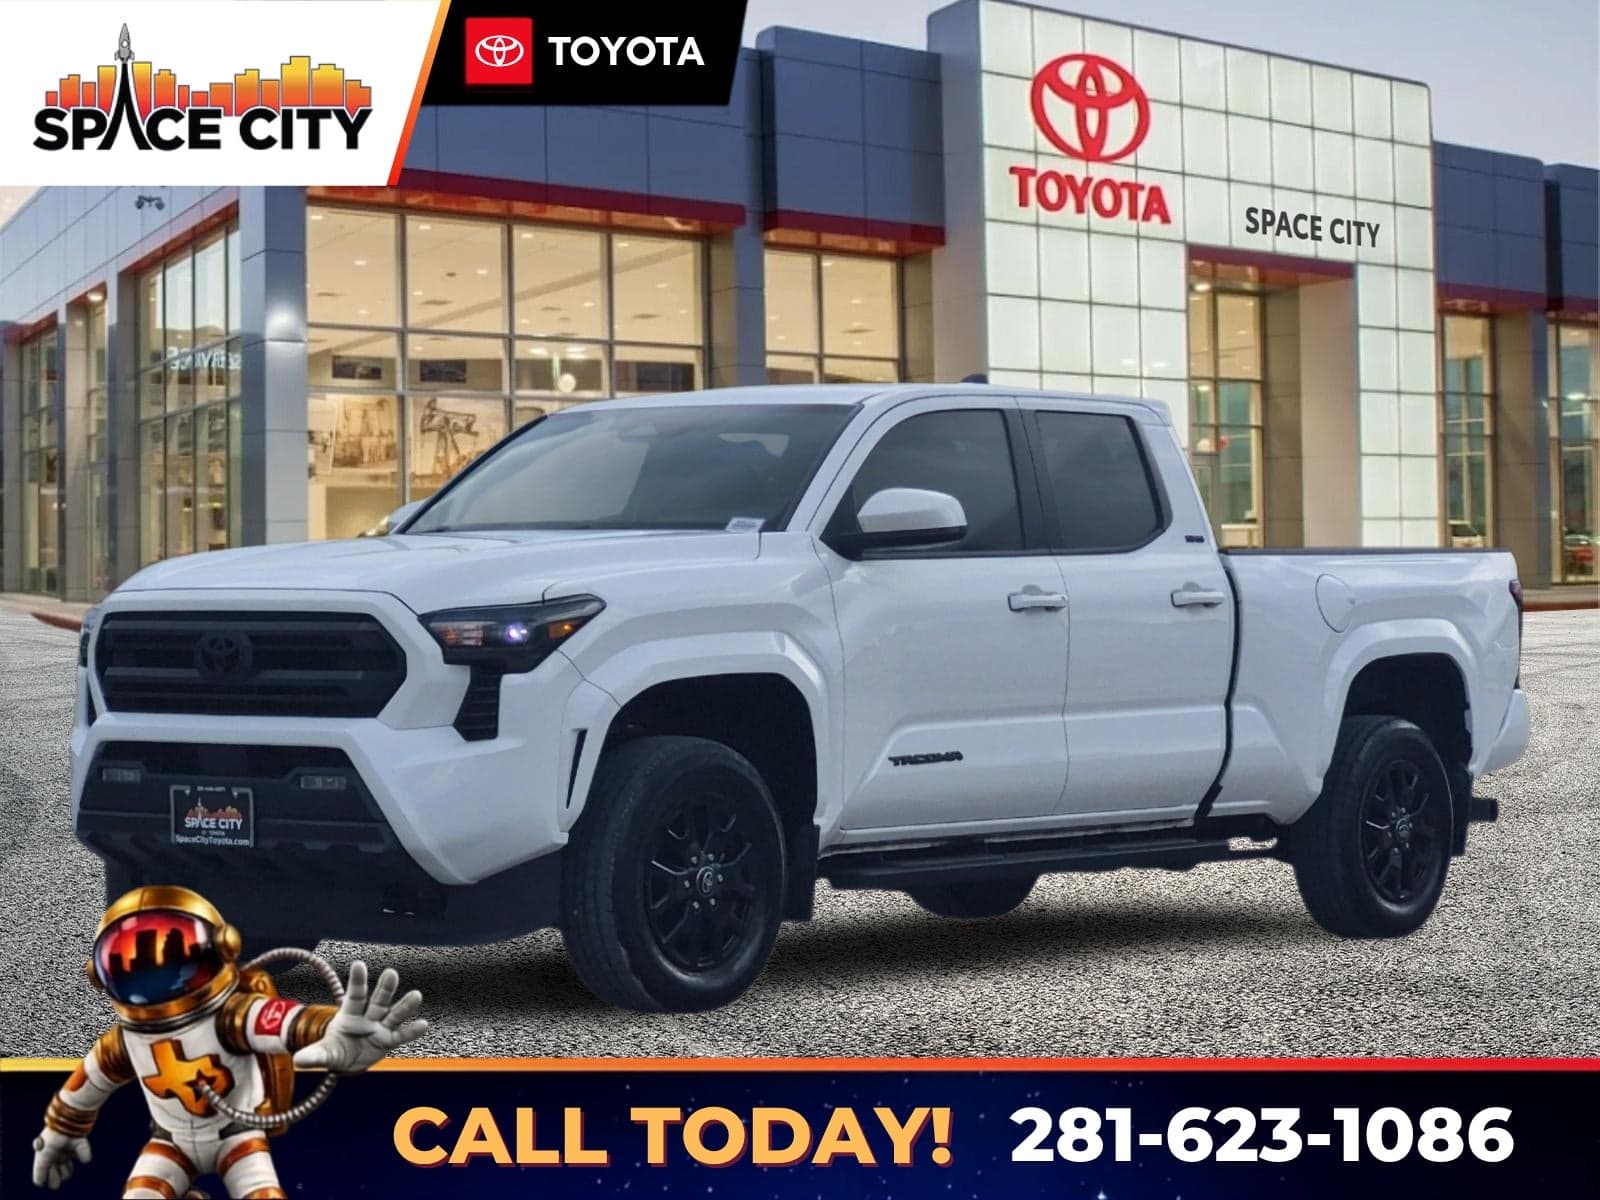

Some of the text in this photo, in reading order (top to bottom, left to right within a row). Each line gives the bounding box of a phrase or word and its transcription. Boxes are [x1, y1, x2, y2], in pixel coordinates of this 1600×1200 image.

[1009, 166, 1171, 225] TOYOTA
[1245, 206, 1381, 248] SPACE CITY
[887, 750, 964, 767] TACOMA
[184, 815, 243, 830] SPACE CITY
[175, 834, 250, 846] SpaceCityToyota.com
